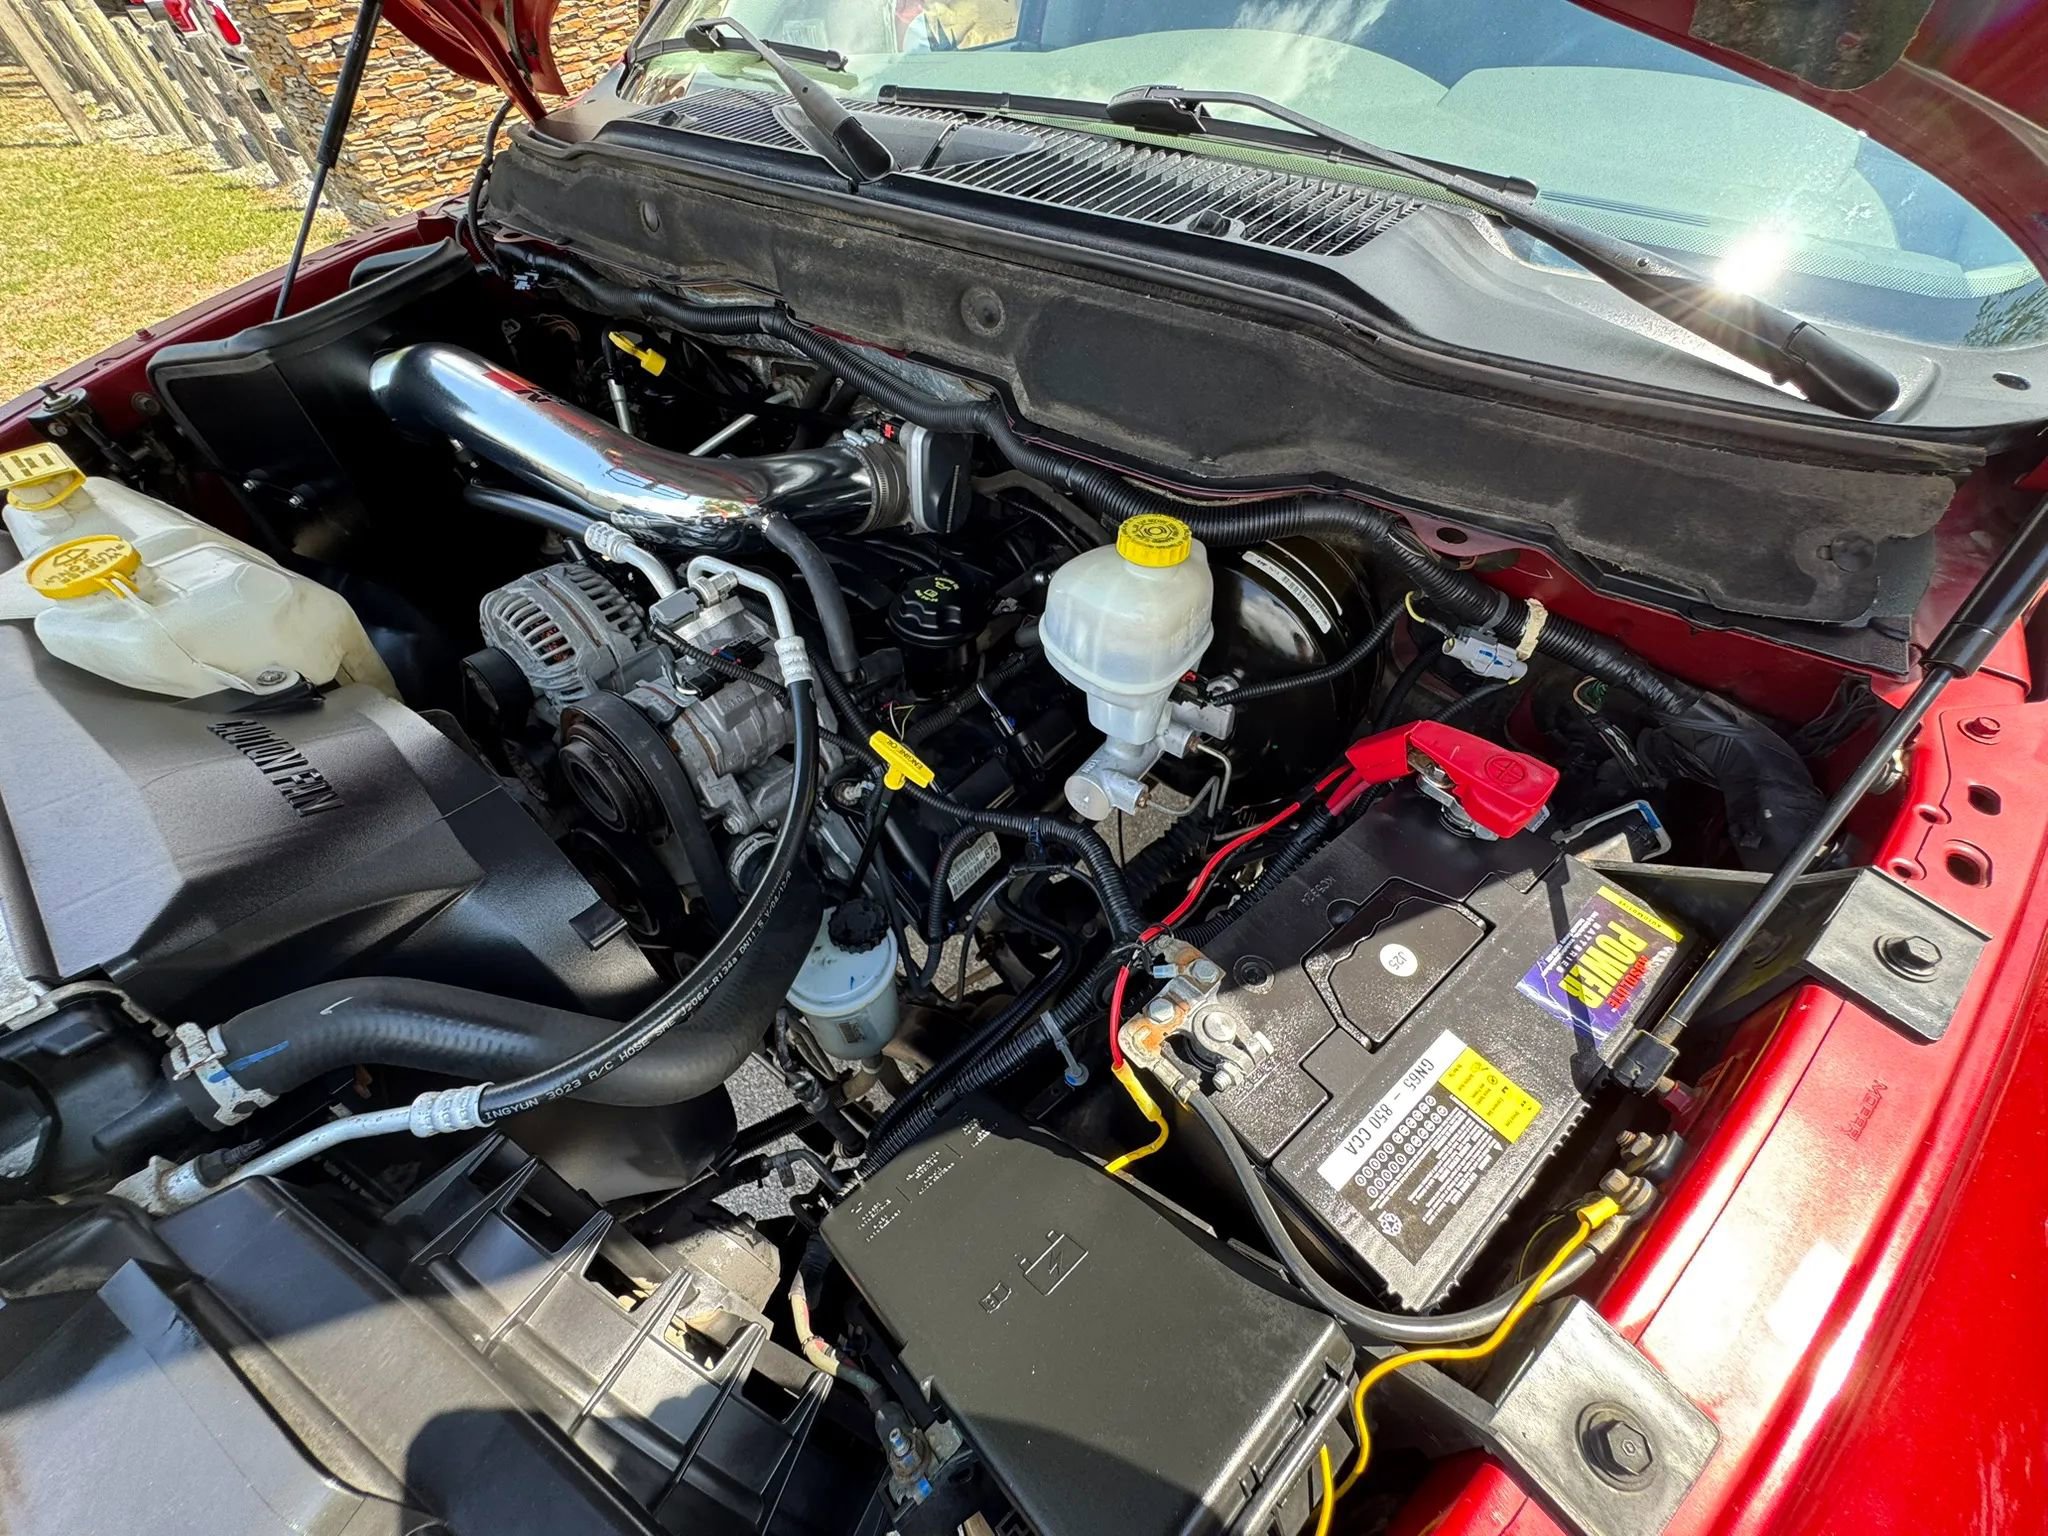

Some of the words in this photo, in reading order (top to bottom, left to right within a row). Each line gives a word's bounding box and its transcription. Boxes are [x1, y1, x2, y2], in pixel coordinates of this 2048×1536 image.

[886, 738, 897, 749] OIL
[898, 748, 923, 770] ENGINE
[206, 719, 309, 773] CAUTION
[272, 768, 344, 817] FAN
[1558, 920, 1646, 1009] POWER
[1606, 955, 1649, 1009] ABSOLUTE
[545, 1078, 582, 1100] 3023
[587, 1061, 614, 1080] A/C
[618, 1037, 650, 1061] HOSE
[654, 1018, 676, 1036] SAE
[1401, 1056, 1435, 1091] GN65
[1367, 1102, 1393, 1129] 850
[1343, 1126, 1372, 1156] CCA
